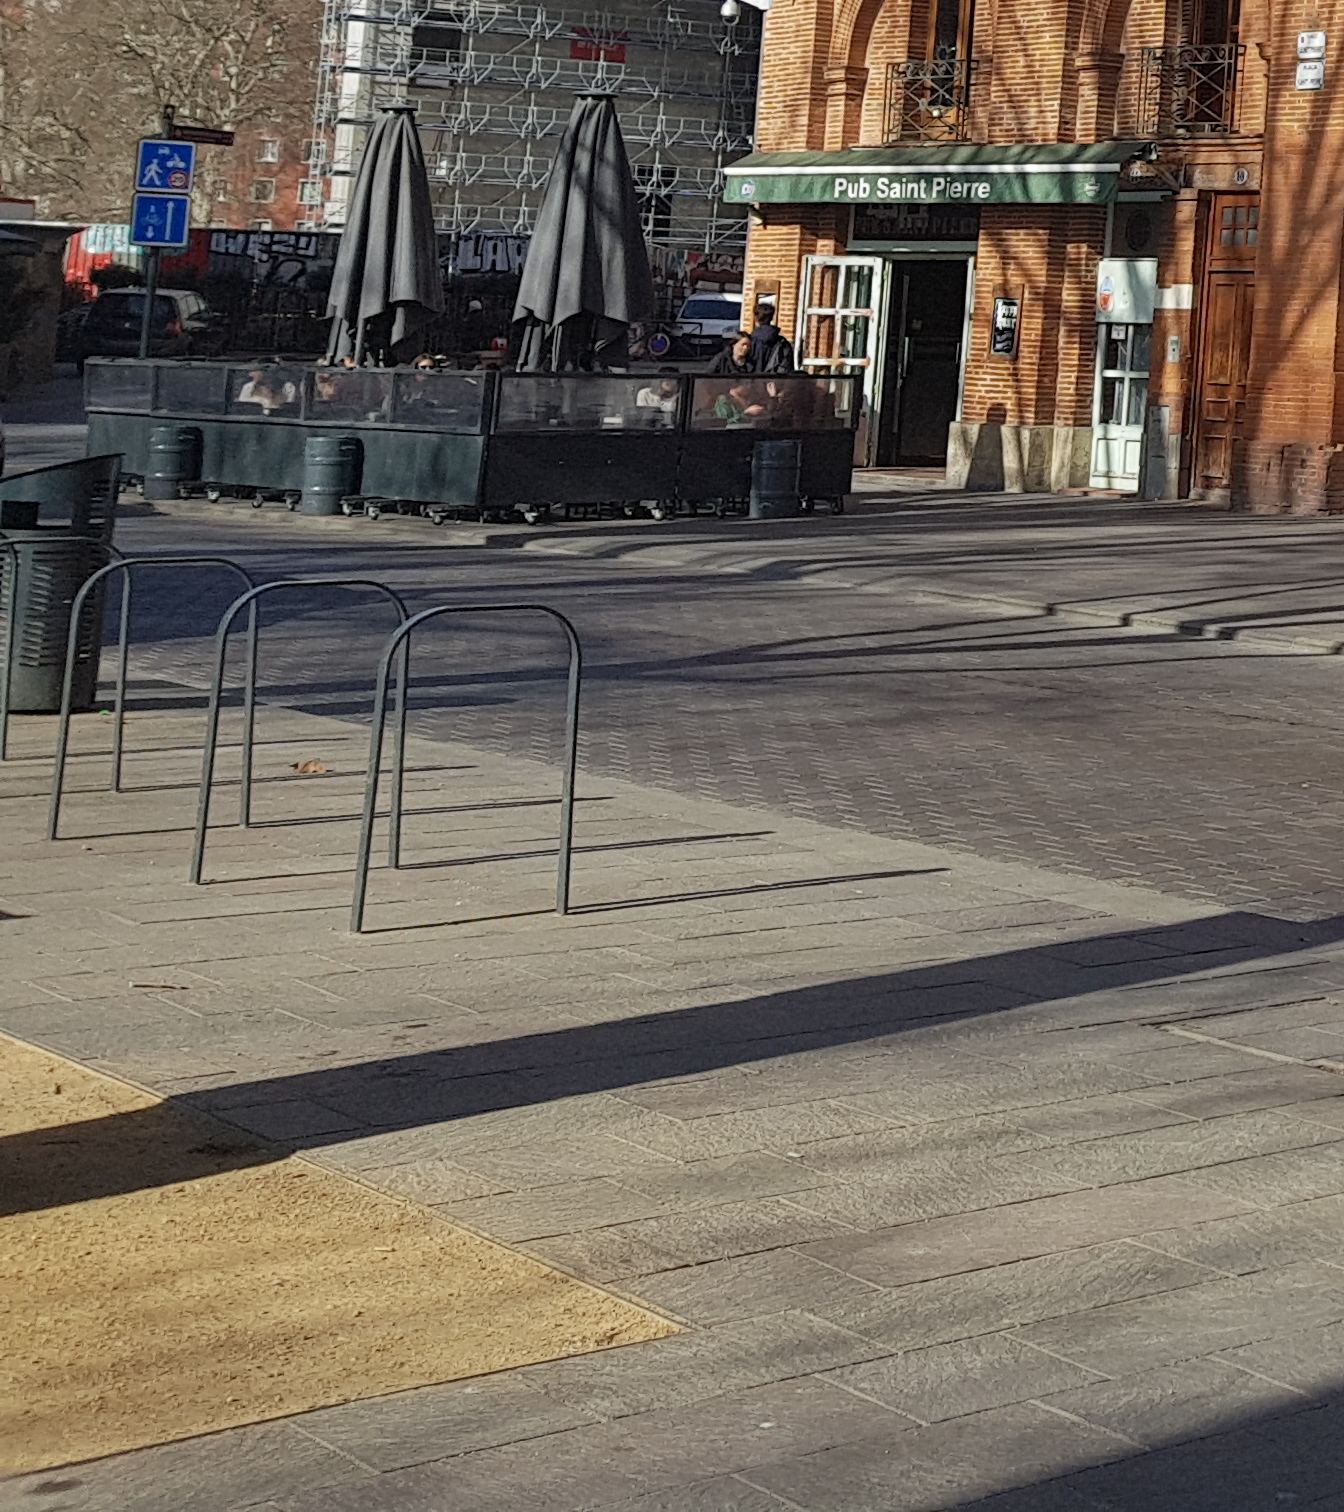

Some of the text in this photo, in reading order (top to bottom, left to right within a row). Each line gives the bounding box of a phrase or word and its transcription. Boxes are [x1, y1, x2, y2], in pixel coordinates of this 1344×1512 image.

[834, 176, 991, 199] Pub Saint Pierre
